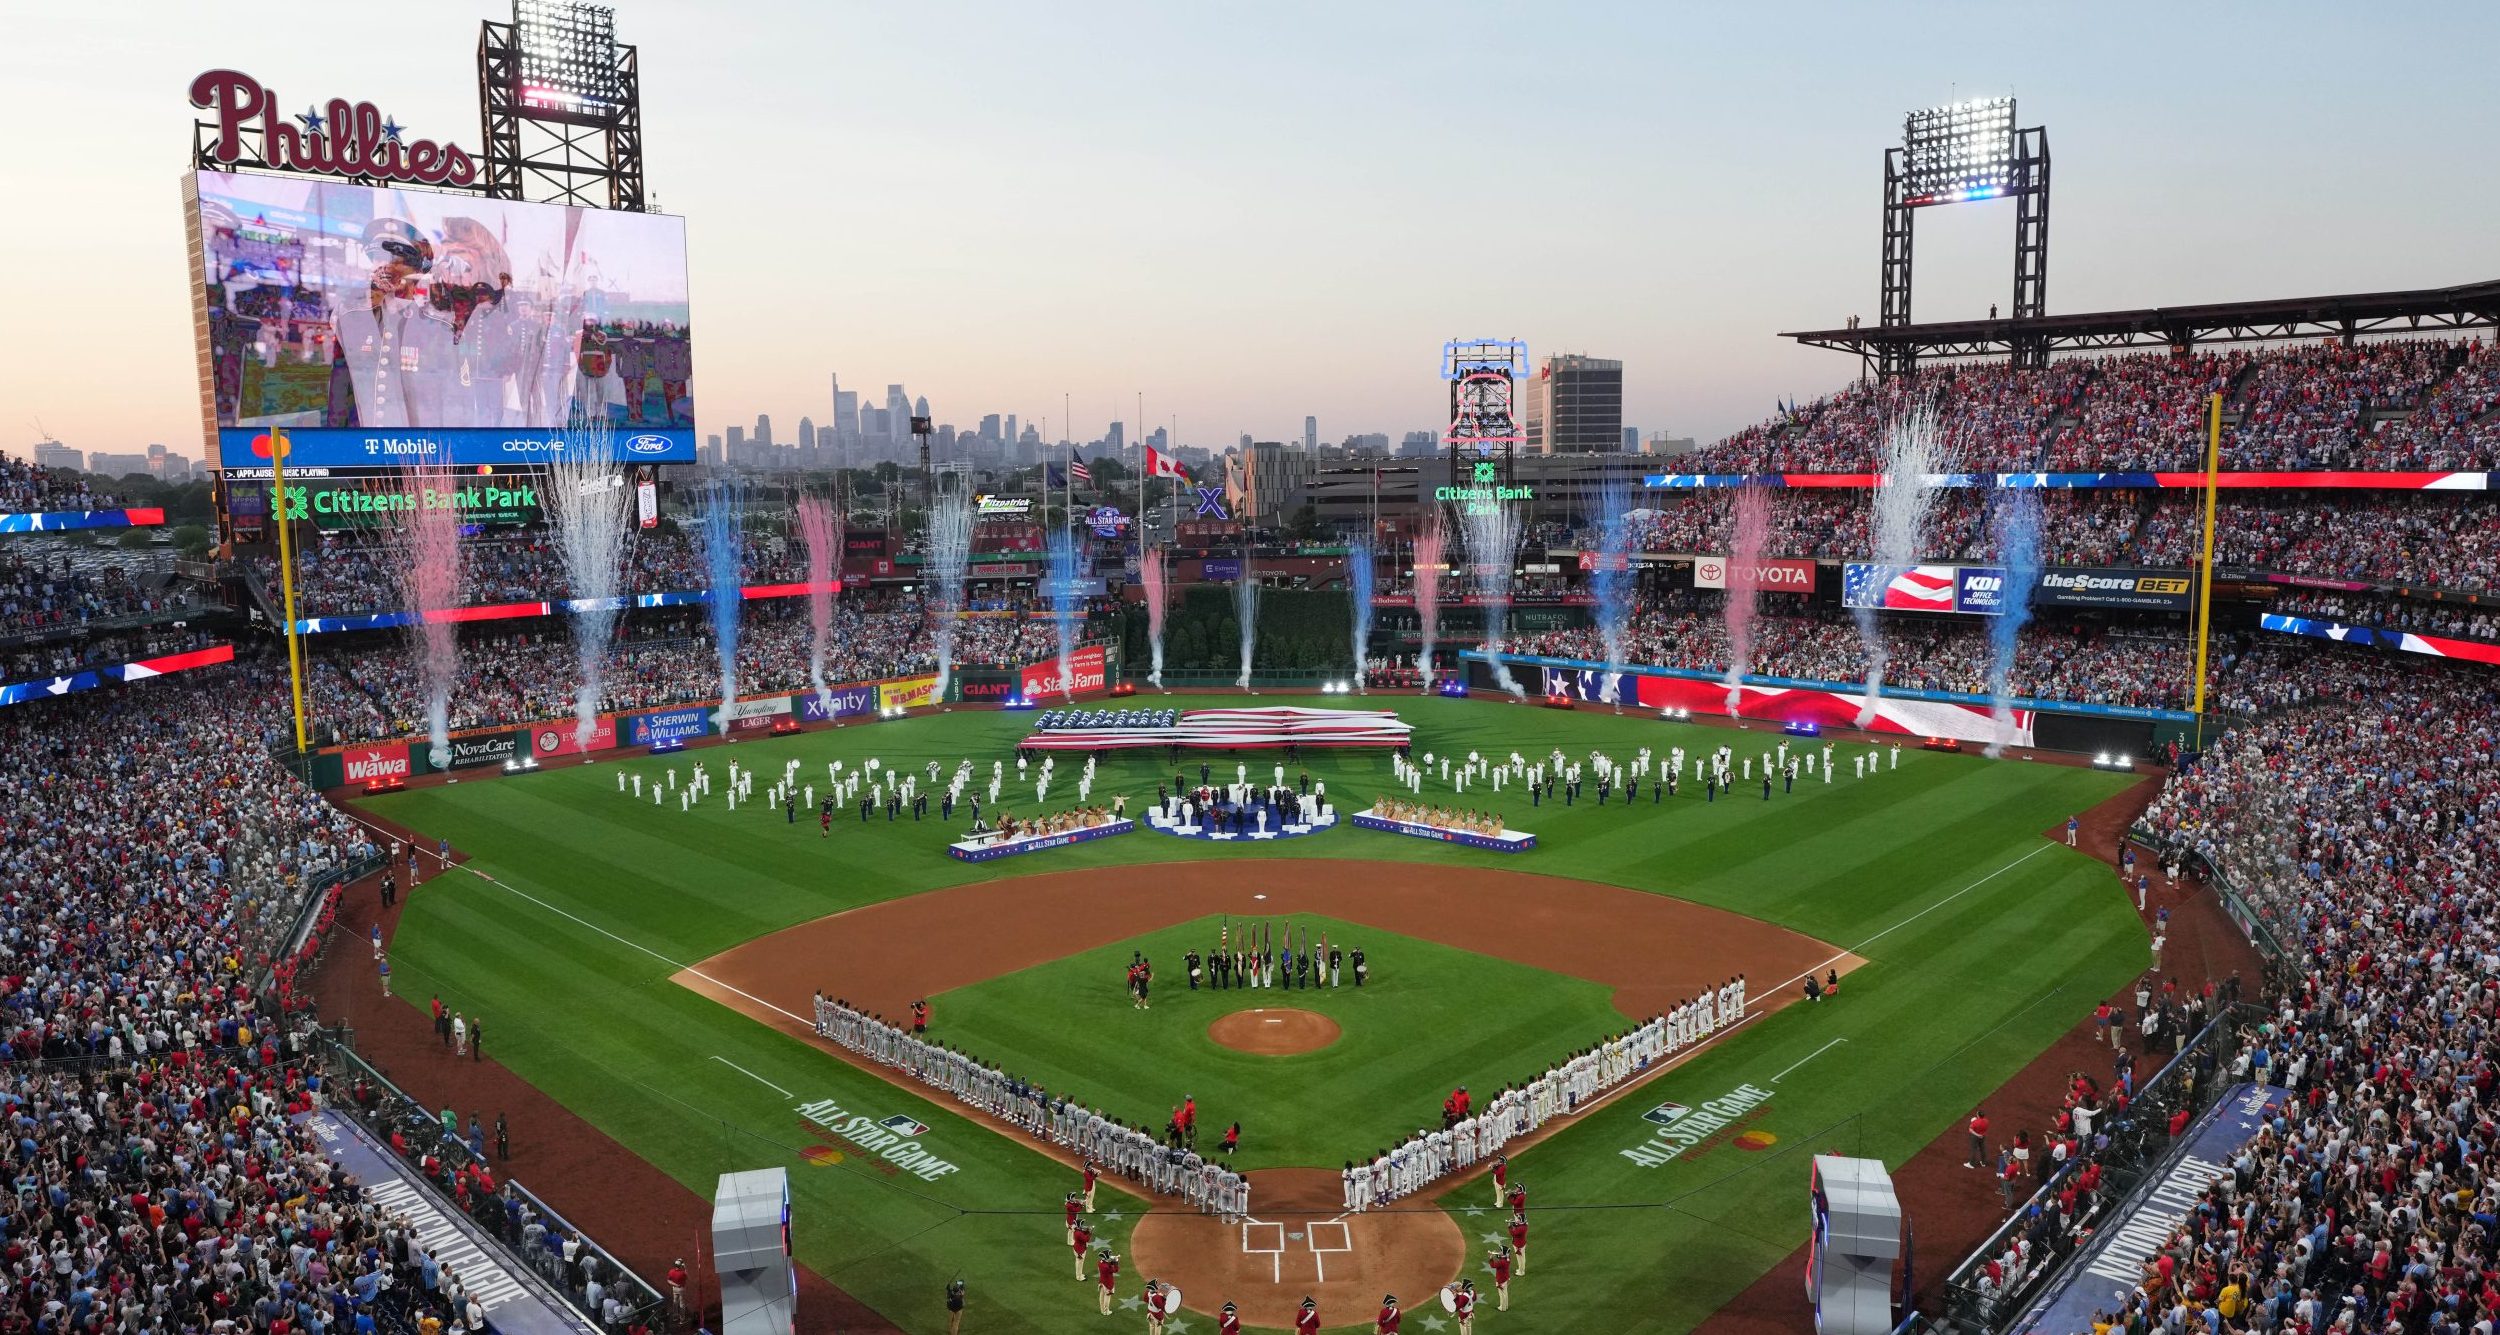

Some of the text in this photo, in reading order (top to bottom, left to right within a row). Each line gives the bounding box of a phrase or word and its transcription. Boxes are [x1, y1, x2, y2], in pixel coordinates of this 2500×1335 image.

[188, 68, 478, 187] Phillies
[383, 439, 437, 455] Mobile
[502, 438, 565, 451] abbvie
[634, 437, 664, 451] Ford
[282, 468, 300, 477] USIC
[300, 468, 330, 478] PLAYING)
[313, 484, 537, 514] Citizens Bank Park
[1435, 484, 1533, 501] Citizens Bank
[979, 494, 1031, 508] Fitzpatrick
[1467, 502, 1498, 516] Park
[1085, 516, 1131, 525] ALL STAR GAME
[848, 540, 881, 549] GIANT
[1730, 565, 1808, 584] TOYOTA
[1964, 576, 2002, 591] KDI
[2042, 573, 2186, 592] theScore BET
[1963, 597, 2001, 606] TECHNOLOGY
[1972, 591, 1993, 600] OFFICE
[1043, 671, 1104, 693] Stae Farm
[890, 684, 938, 706] W.B.MASO
[963, 684, 1011, 695] GIANT
[658, 702, 696, 712] ASPLUNDH
[703, 697, 739, 707] ASPLUH
[807, 691, 866, 717] xfnity
[2059, 703, 2081, 711] ibx.com
[611, 708, 651, 718] ASPLUNDH
[734, 702, 778, 717] Yuengling
[2107, 706, 2146, 716] Independence
[2166, 712, 2190, 720] ibx.com
[511, 719, 557, 730] ASPLUNDH
[562, 714, 603, 725] ASPDH
[651, 712, 699, 728] SHERWIN
[741, 716, 771, 728] LAGER
[457, 726, 502, 737] ASPLUNDH
[583, 727, 611, 738] EBB
[651, 725, 700, 740] WILLIAMS
[343, 740, 393, 752] ASPLUNDH
[454, 738, 516, 757] NovaCare
[573, 737, 600, 746] CANY
[454, 751, 514, 766] REHABILITATION
[347, 758, 406, 780] Wawa
[1409, 826, 1444, 840] ALL STAR GAME
[1035, 836, 1070, 849] ALL STAR GAME
[1618, 1083, 1776, 1169] ALL STAR GAME
[793, 1098, 961, 1182] ALL STAR GAME
[2148, 1154, 2224, 1212] LEAGUE
[364, 1177, 471, 1252] AMERICAN
[2085, 1205, 2188, 1287] NATIONAL
[437, 1242, 531, 1312] LEAGUE
